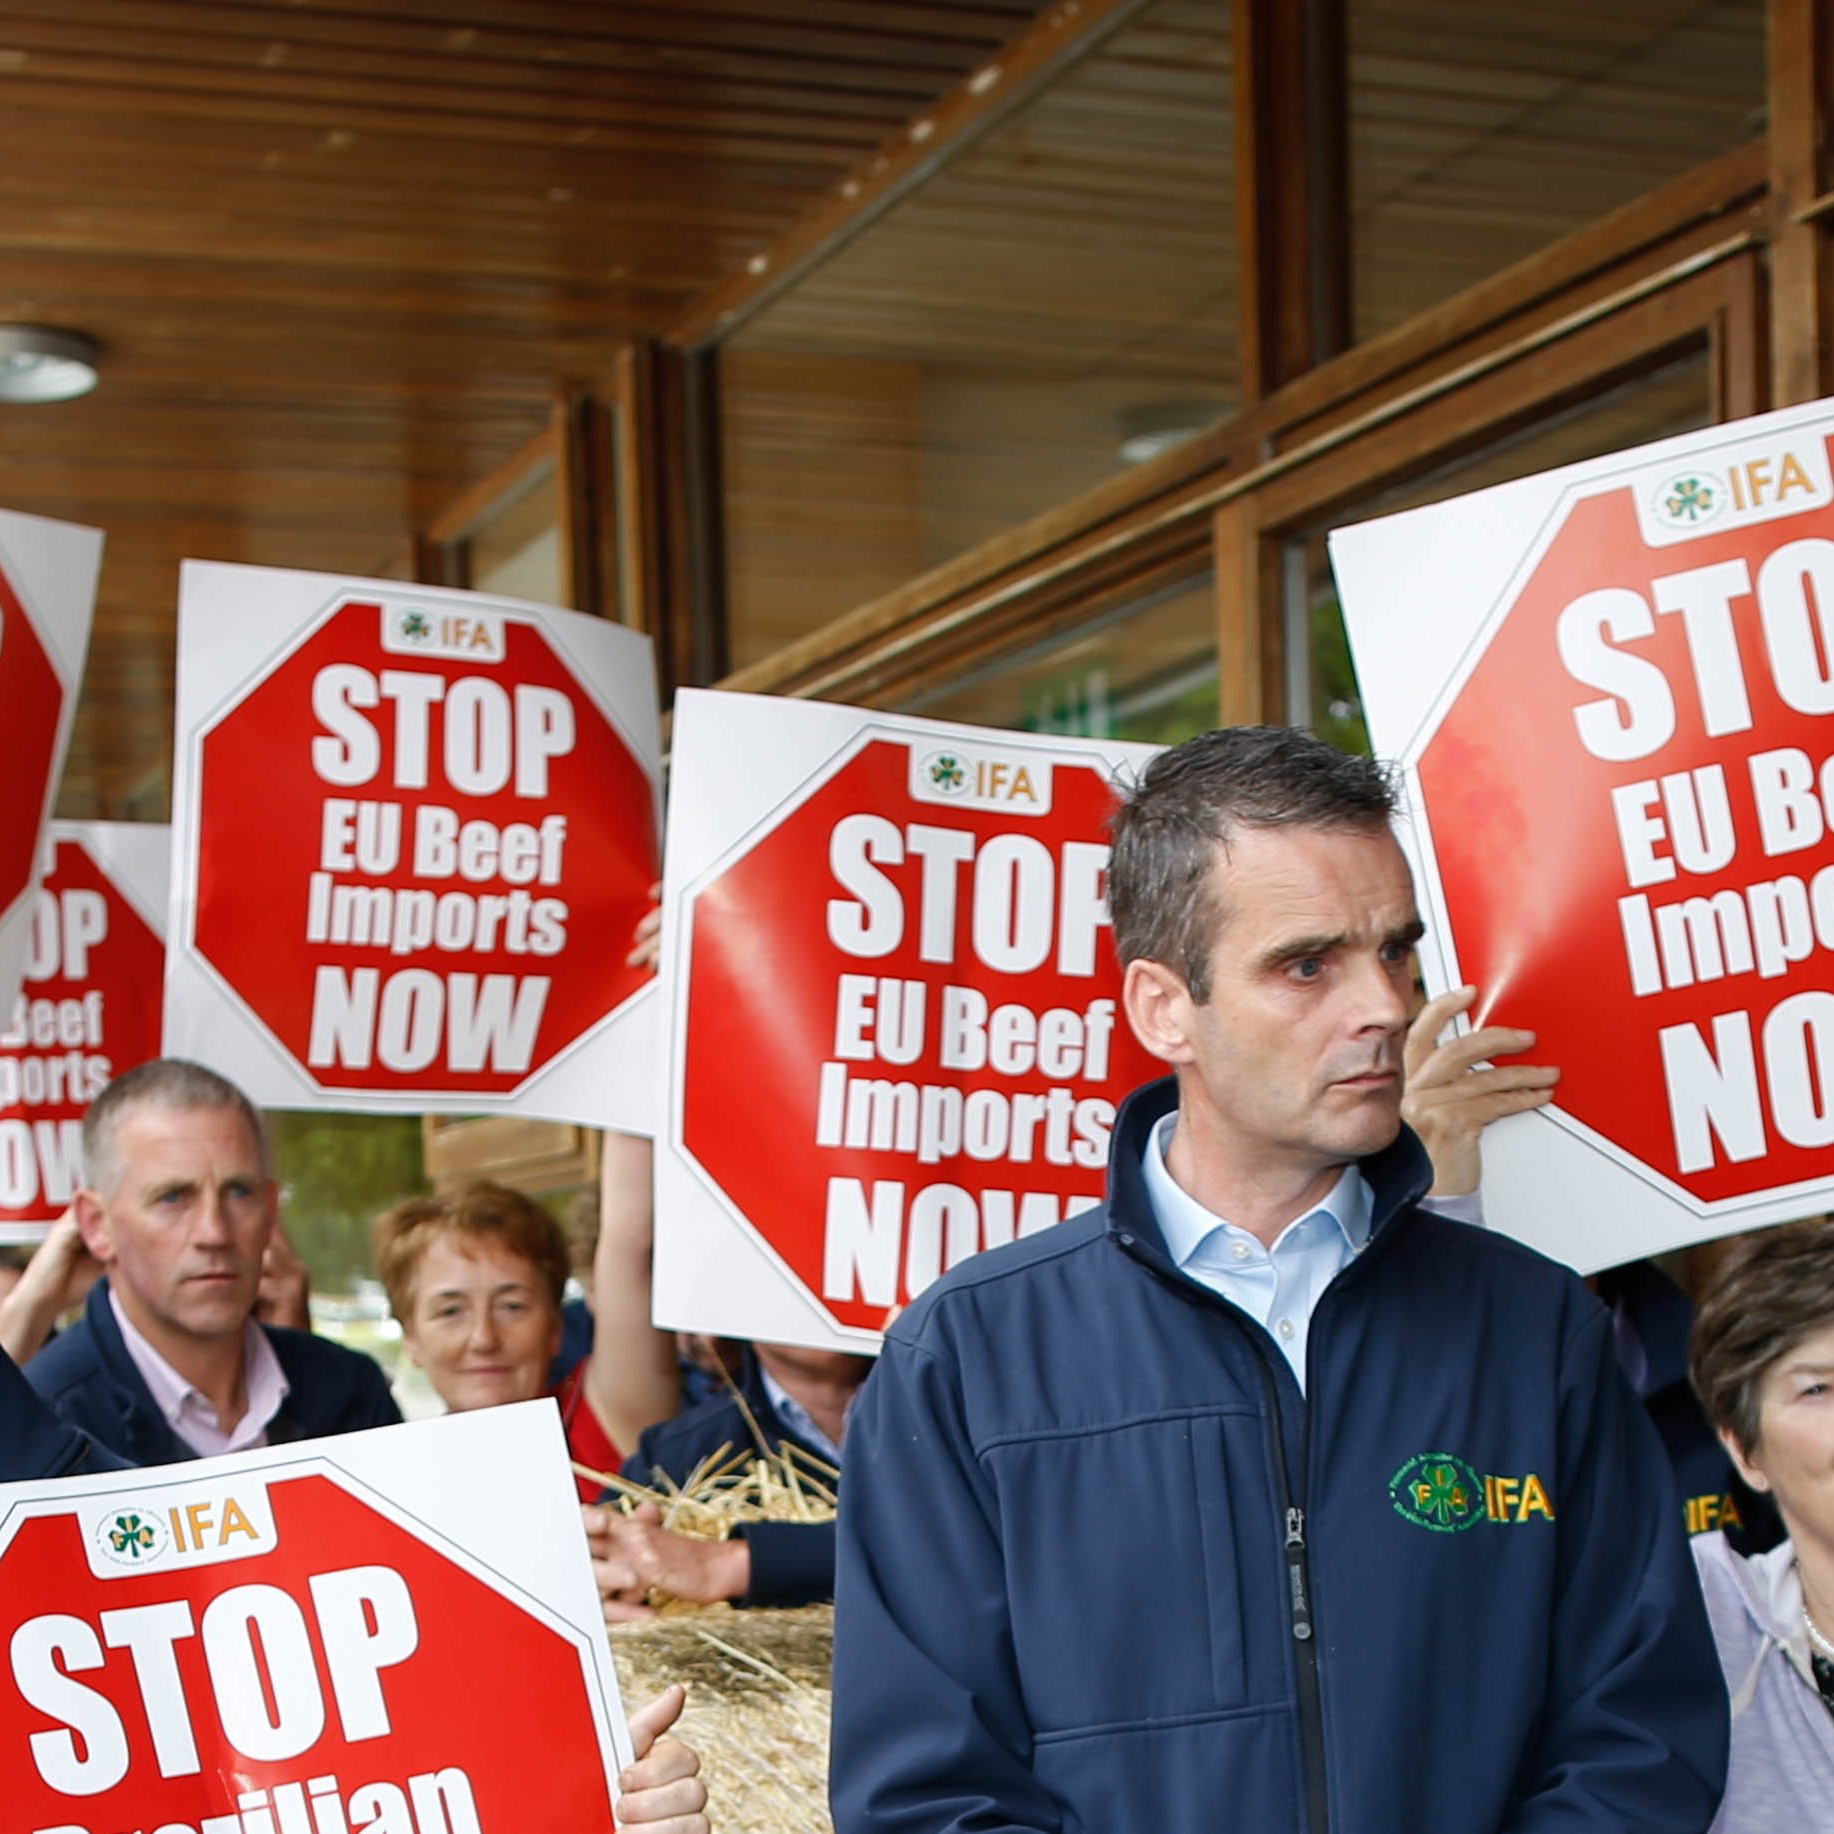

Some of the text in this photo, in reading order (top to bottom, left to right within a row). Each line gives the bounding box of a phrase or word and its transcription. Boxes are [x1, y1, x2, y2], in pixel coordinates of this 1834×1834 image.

[1727, 453, 1817, 512] IFA
[442, 617, 494, 650] IFA
[311, 662, 576, 799] STOP
[975, 760, 1039, 803] IFA
[320, 797, 567, 885] EU Beef
[1610, 764, 1737, 888] EU
[306, 872, 569, 955] Imports
[826, 813, 1113, 976] STOP
[308, 965, 552, 1074] NOW
[834, 973, 1117, 1082] EU Beef
[815, 1062, 1115, 1170] Imports
[168, 1497, 260, 1553] IFA
[1484, 1474, 1555, 1523] IFA
[1686, 1494, 1744, 1534] IFA
[9, 1564, 420, 1797] STOP
